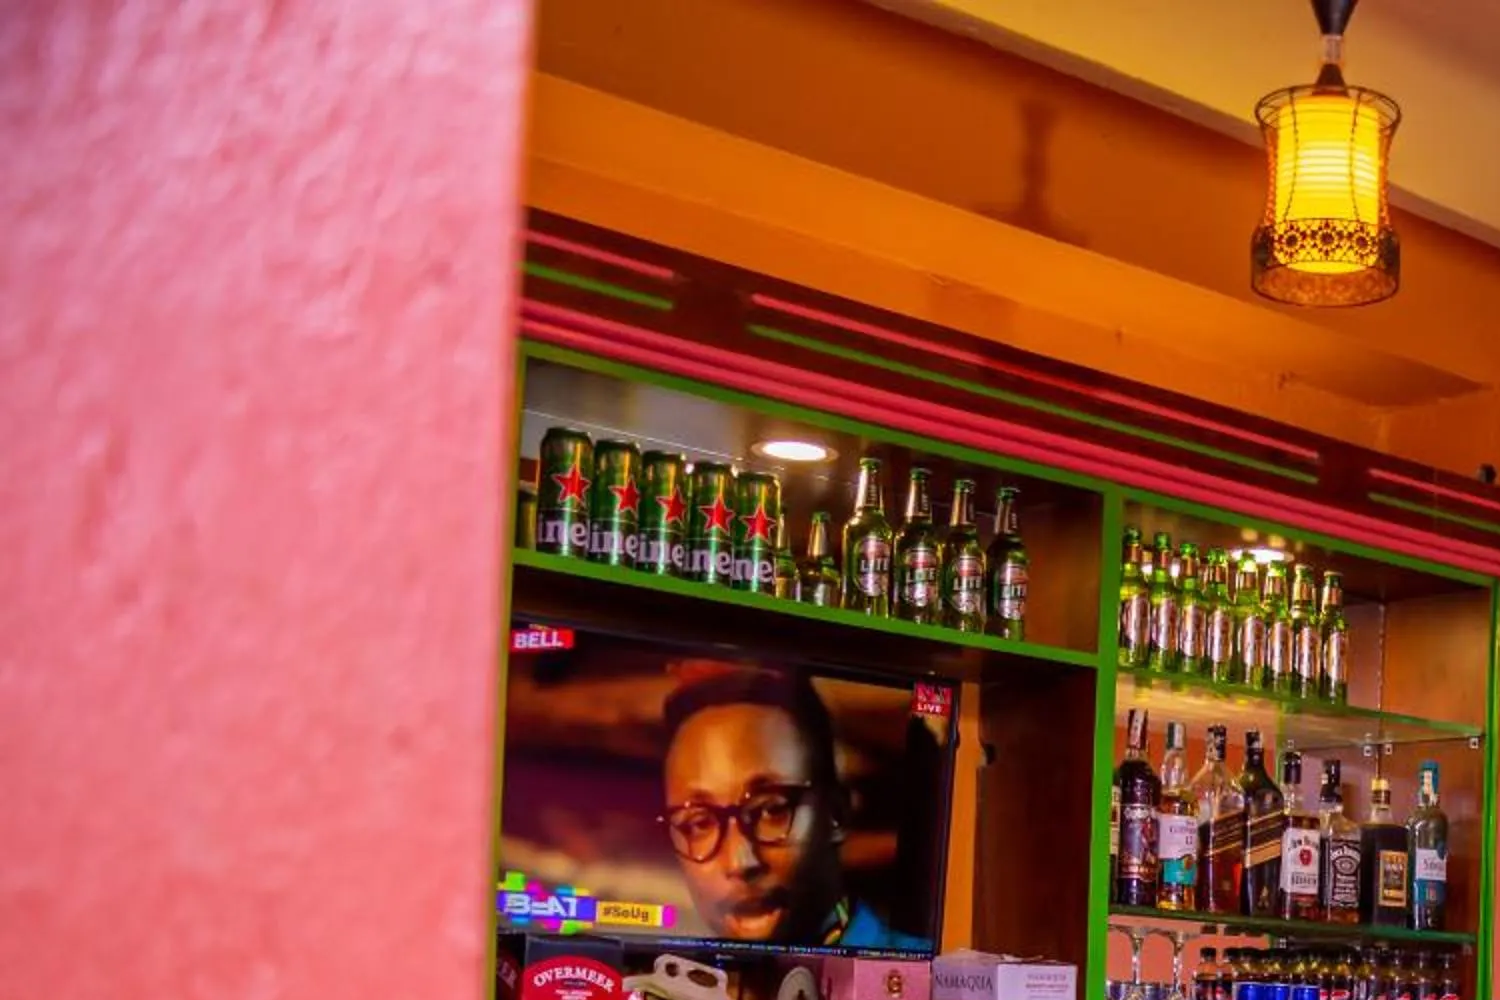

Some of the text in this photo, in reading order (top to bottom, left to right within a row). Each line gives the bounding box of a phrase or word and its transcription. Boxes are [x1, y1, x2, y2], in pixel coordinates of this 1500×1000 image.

[514, 631, 564, 650] BELL
[916, 702, 942, 713] LIVE
[532, 965, 616, 993] OVERMEER
[935, 973, 994, 992] NAMAQUA
